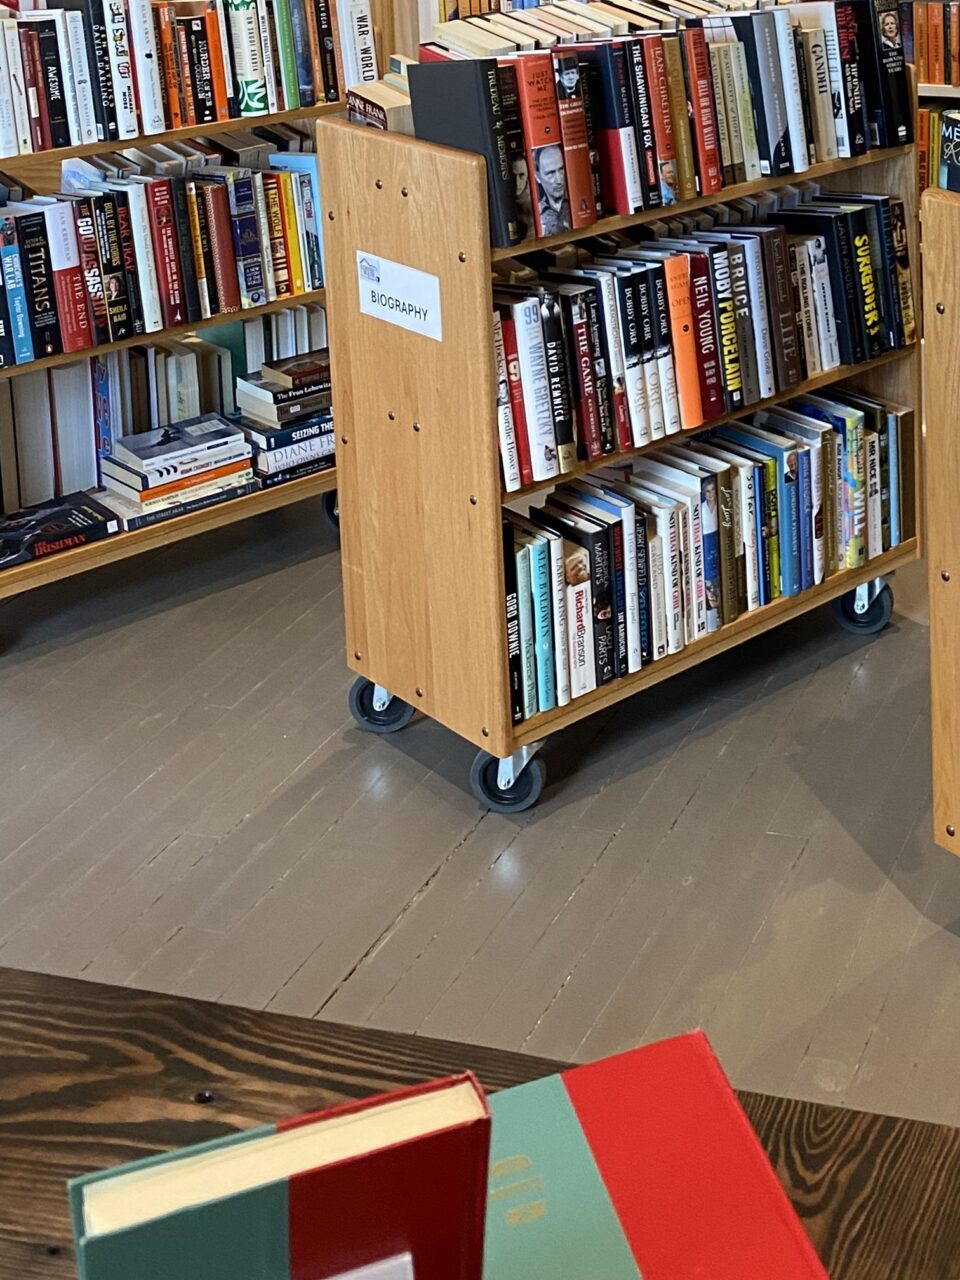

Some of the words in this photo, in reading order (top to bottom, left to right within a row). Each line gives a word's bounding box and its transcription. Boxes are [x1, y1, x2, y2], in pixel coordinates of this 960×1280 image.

[356, 14, 370, 37] WAR
[93, 24, 103, 56] DAVID
[98, 62, 109, 107] DARLING
[359, 46, 376, 82] WORLD
[632, 45, 642, 65] THE
[811, 43, 829, 95] GANDHI
[48, 66, 61, 100] AWESOME
[126, 85, 134, 114] MICHAEL
[487, 68, 502, 116] TRUDEAU
[634, 65, 650, 129] SHAWINIGAN
[643, 130, 654, 149] FOX
[269, 189, 278, 209] THE
[271, 210, 282, 237] WOLF
[28, 248, 50, 312] TITANS
[693, 276, 709, 308] NEIL
[712, 250, 733, 299] MOBY
[730, 253, 750, 319] BRUCE
[854, 234, 879, 328] SURRENDER
[371, 290, 428, 322] BIOGRAPHY
[638, 283, 648, 315] BOBBY
[643, 316, 652, 341] ORR
[655, 279, 665, 311] BOBBY
[624, 287, 634, 321] BOBBY
[629, 322, 637, 345] ORR
[659, 312, 668, 335] ORR
[698, 310, 715, 355] YOUNG
[587, 323, 599, 355] THE
[719, 300, 742, 391] PORCELAIN
[528, 341, 544, 384] WAYNE
[546, 342, 558, 375] DAVID
[580, 356, 594, 396] GAME
[533, 384, 553, 442] GRETZKY
[550, 377, 562, 423] REMNICK
[291, 425, 320, 441] SEIZING
[321, 421, 334, 433] THE
[273, 442, 317, 463] DIANE
[865, 440, 874, 458] MR
[866, 458, 876, 483] NICE
[505, 592, 518, 619] GORD
[541, 585, 550, 638] BALDWIN
[508, 619, 521, 659] DOWNIE
[598, 634, 608, 665] PARTS
